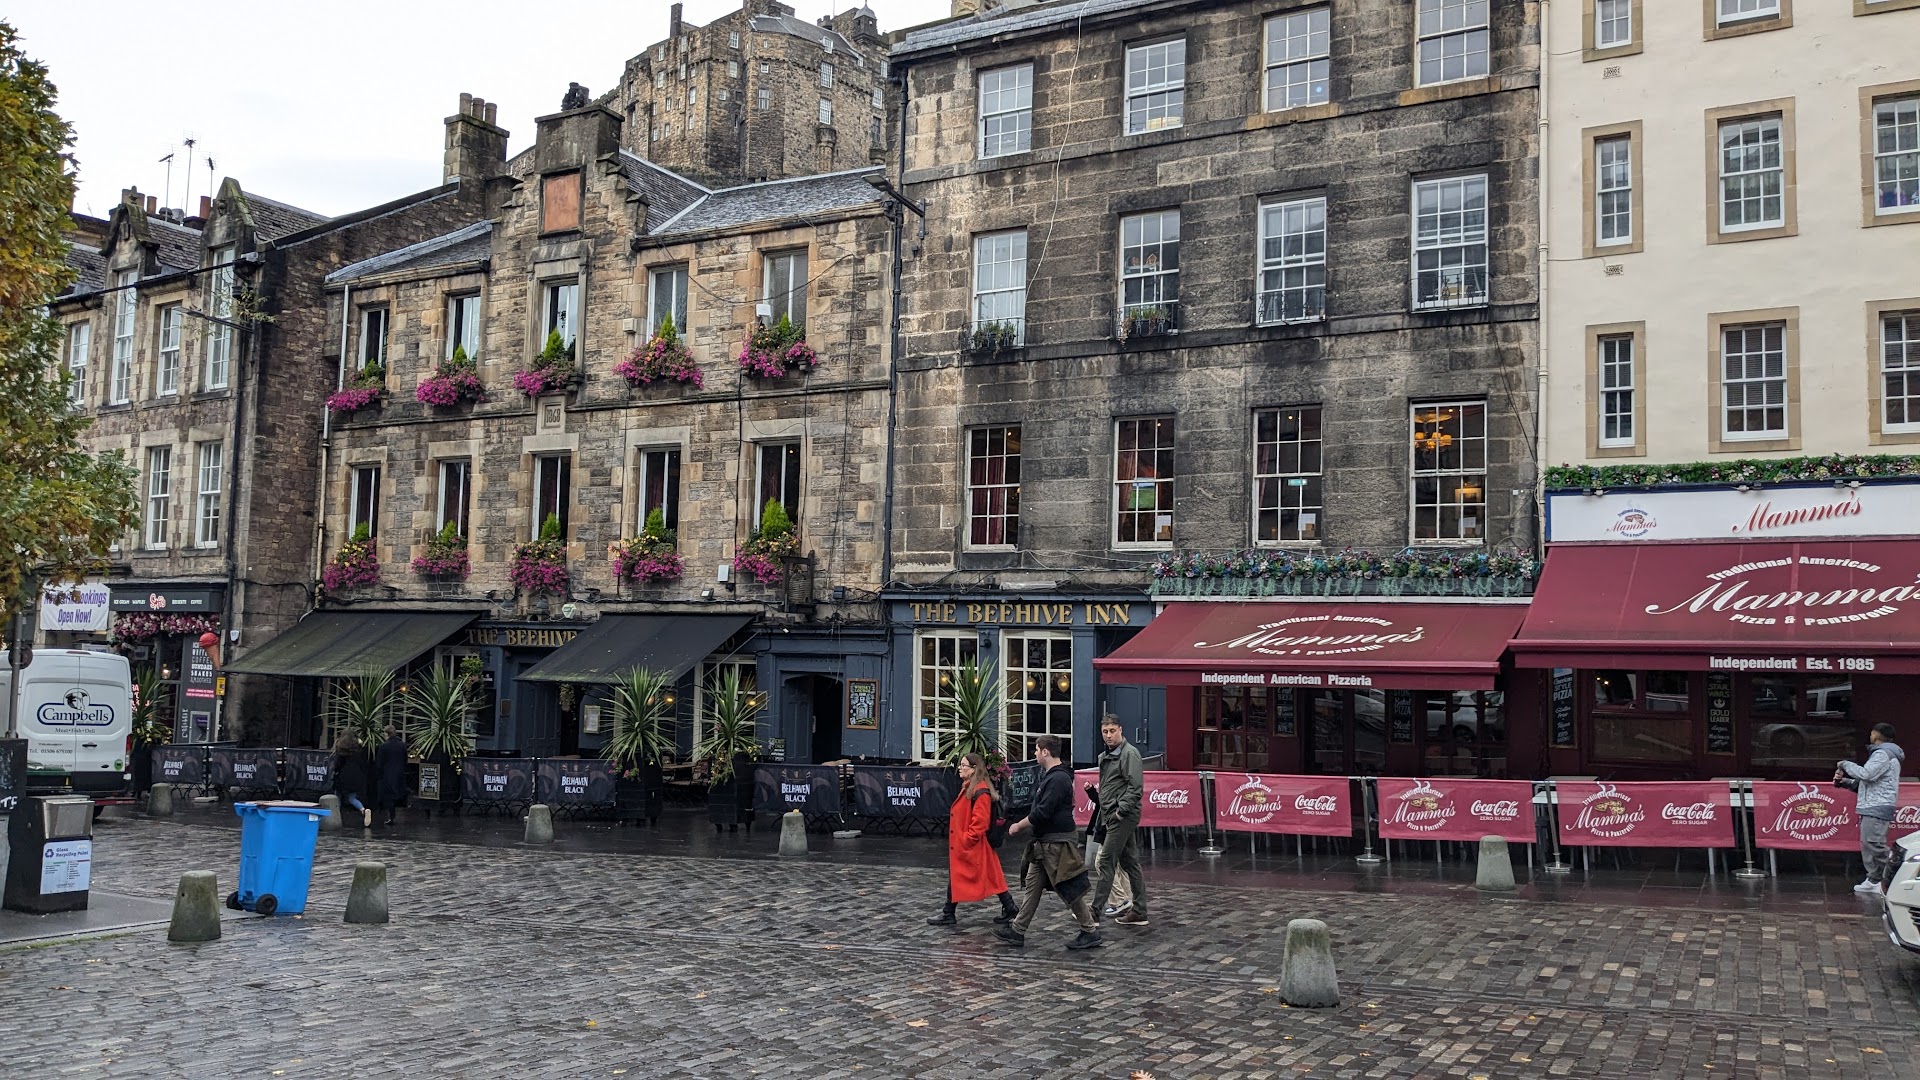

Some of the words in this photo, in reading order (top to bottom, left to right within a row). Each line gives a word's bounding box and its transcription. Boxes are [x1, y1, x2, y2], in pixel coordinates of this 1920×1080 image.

[1732, 491, 1863, 533] Mamma's
[1606, 518, 1657, 532] Mamma's
[1706, 557, 1793, 581] Traditional
[1799, 556, 1881, 573] American
[75, 590, 107, 607] ookings
[58, 609, 74, 626] Open
[75, 609, 92, 623] Now!
[909, 602, 957, 623] THE
[967, 603, 1073, 625] BEEHIVE
[1085, 603, 1130, 625] INN
[1729, 614, 1776, 625] Pizza
[1785, 616, 1796, 624] &
[1805, 605, 1899, 626] Panzerotti
[1257, 615, 1330, 630] Traditional
[1333, 615, 1393, 627] American
[465, 628, 498, 644] THE
[1193, 626, 1425, 649] Mamma's
[1252, 647, 1287, 655] Pizza
[1709, 656, 1797, 671] Independent
[1806, 658, 1833, 670] Est.
[1837, 658, 1875, 670] 1985
[1201, 672, 1265, 685] Independent
[1270, 674, 1322, 685] American
[1328, 675, 1372, 686] Pizzeria
[1554, 682, 1572, 691] STYLE
[1554, 689, 1572, 701] PIZZA
[42, 708, 109, 724] Campbells
[234, 763, 257, 773] BELHAVEN
[306, 765, 327, 774] BELHAVEN
[484, 774, 508, 785] BELHAVEN
[561, 776, 588, 786] BELHAVEN
[781, 783, 810, 795] BELHAVEN
[887, 786, 921, 798] BELHAVEN
[1149, 789, 1189, 804] Coca-Cola
[785, 794, 806, 802] BLACK
[892, 797, 916, 806] BLACK
[1220, 795, 1282, 816] Mamma's
[1294, 794, 1337, 811] Coca-Cola
[1384, 800, 1456, 825] Mamma's
[1471, 800, 1519, 816] Coca-Cola
[1662, 802, 1716, 820] Coca-Cola
[1239, 814, 1250, 823] Pizza
[1566, 804, 1645, 830] Mamma's
[1762, 807, 1850, 834] Mamma's
[1406, 822, 1419, 831] Pizza
[1590, 827, 1604, 837] Pizza
[1790, 830, 1805, 840] Pizza
